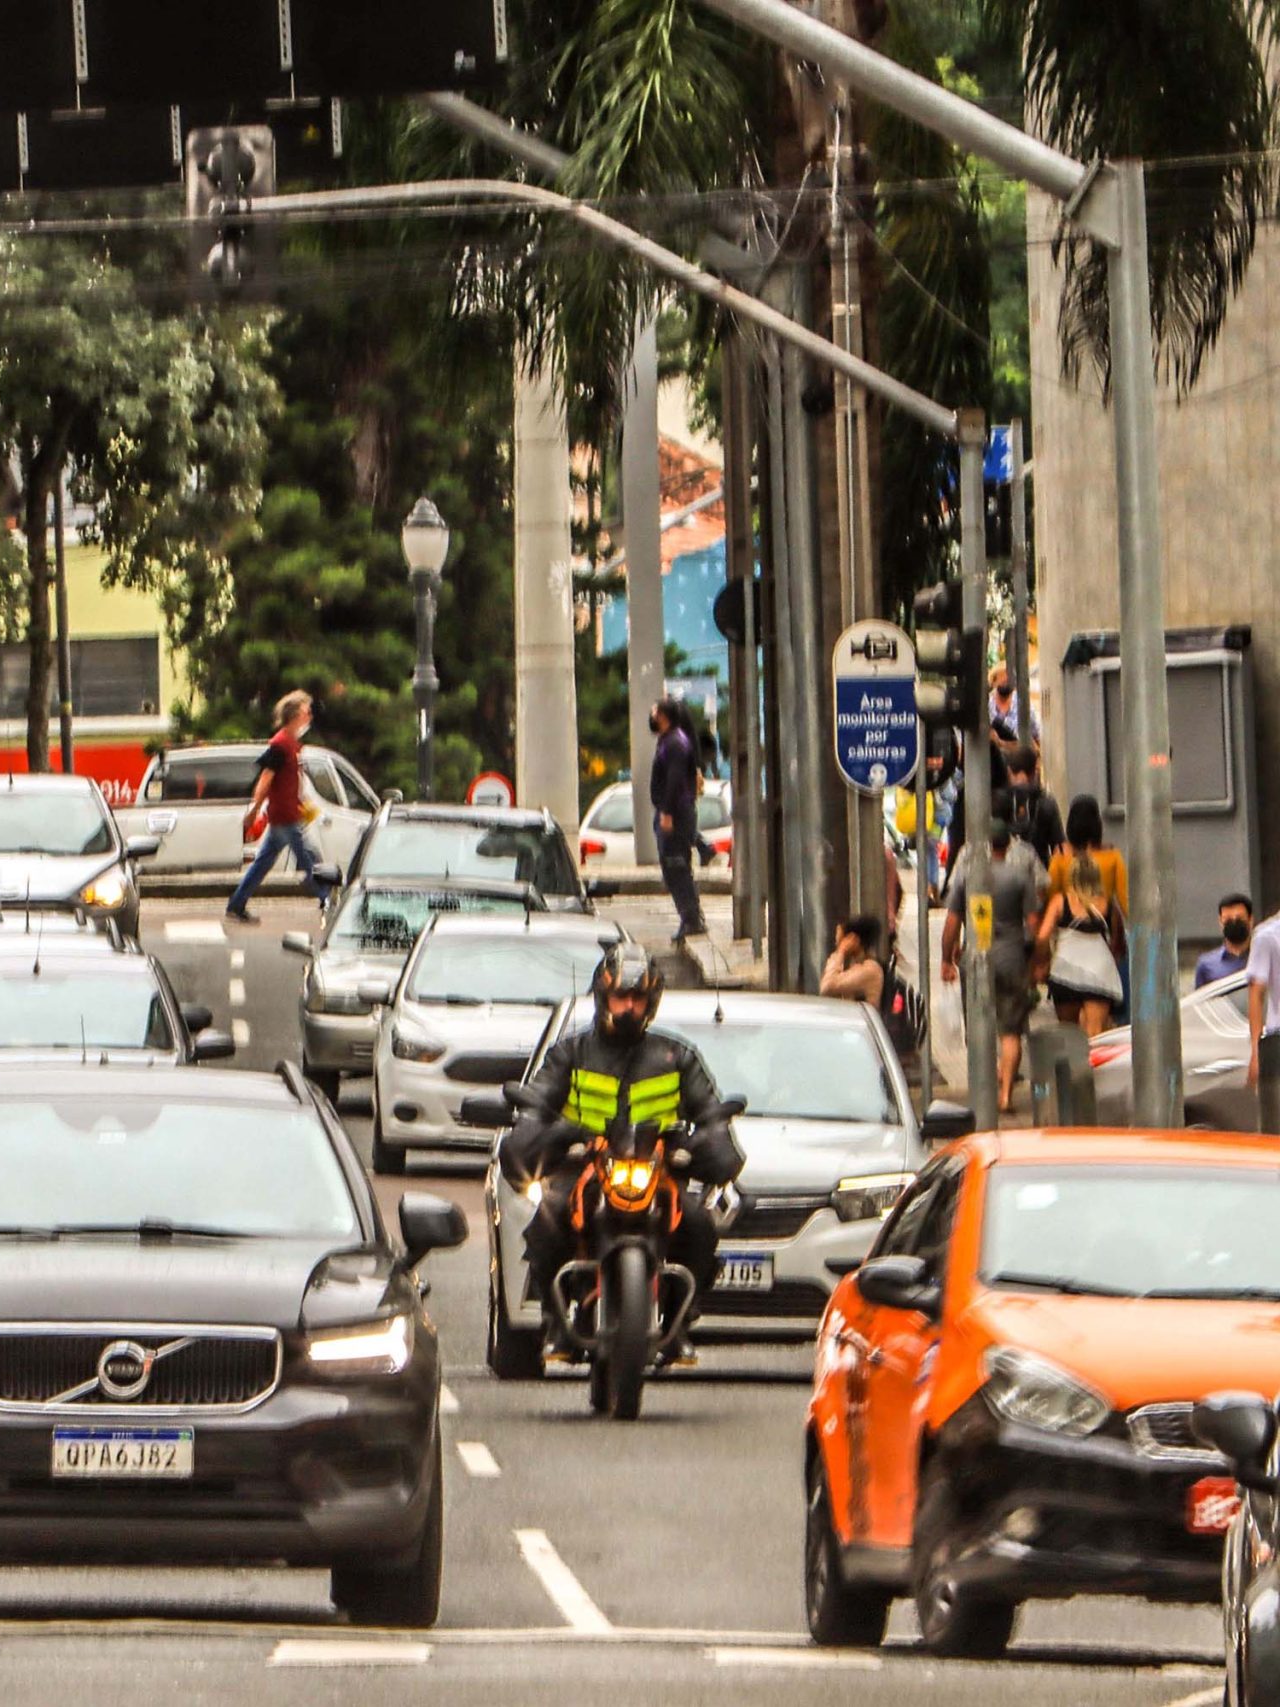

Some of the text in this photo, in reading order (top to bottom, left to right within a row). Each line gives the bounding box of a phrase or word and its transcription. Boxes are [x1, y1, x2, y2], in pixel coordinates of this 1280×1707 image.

[837, 710, 915, 728] monitorada
[865, 729, 888, 746] por
[66, 1442, 177, 1468] QPA6J82
